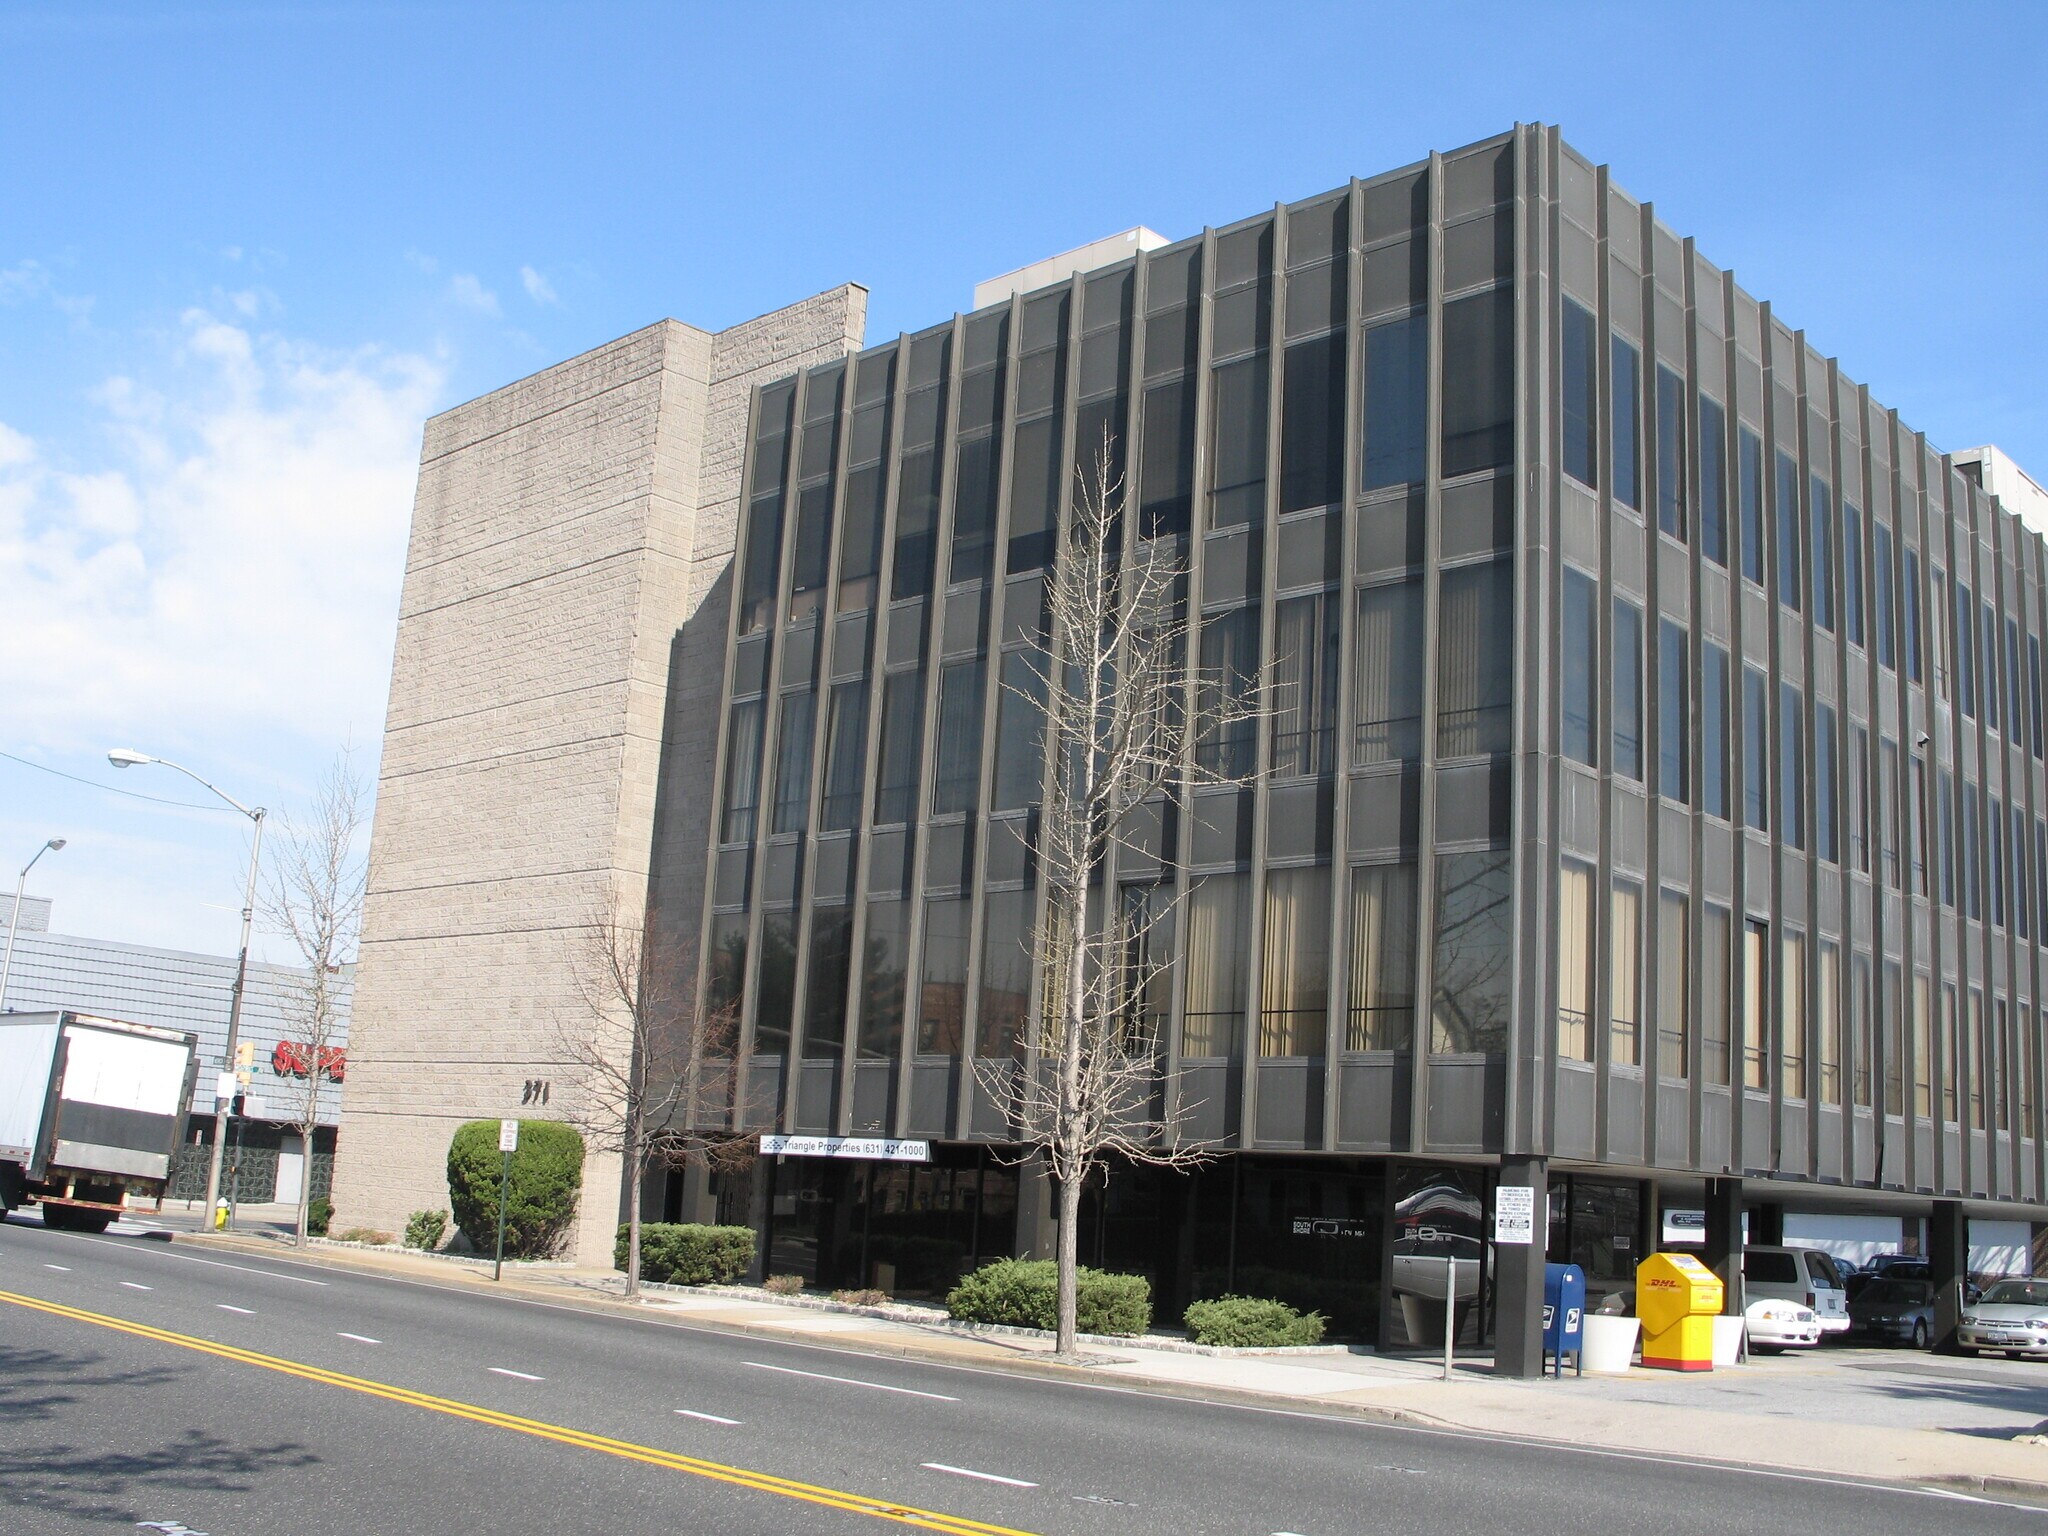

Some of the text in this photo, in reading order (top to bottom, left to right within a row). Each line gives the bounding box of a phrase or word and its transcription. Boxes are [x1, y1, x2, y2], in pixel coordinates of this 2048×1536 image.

[783, 1139, 924, 1157] Triangle Properties (631) 421-1000
[1650, 1279, 1677, 1288] DHL
